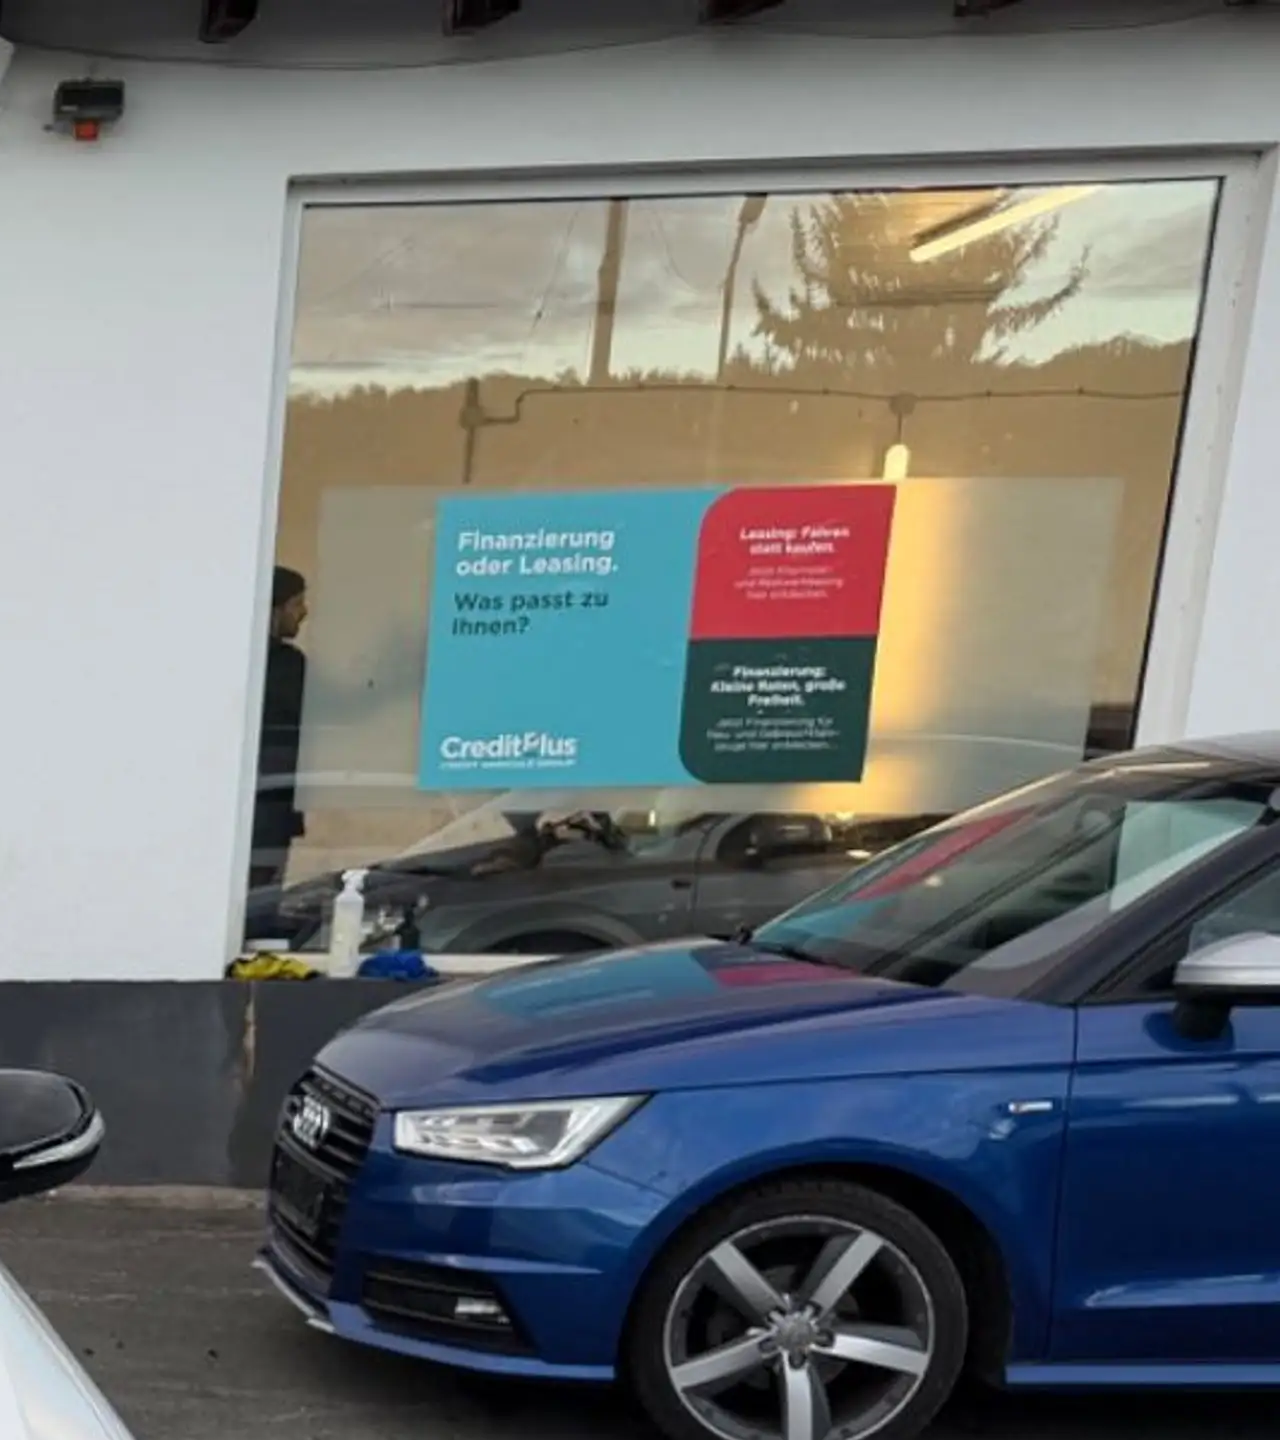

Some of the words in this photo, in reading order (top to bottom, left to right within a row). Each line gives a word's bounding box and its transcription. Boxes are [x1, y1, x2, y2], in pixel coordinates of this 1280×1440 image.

[458, 529, 616, 551] Finanzierung
[456, 556, 513, 577] oder
[519, 553, 619, 576] Leasing.
[454, 591, 504, 612] Was
[510, 590, 574, 613] passt
[580, 591, 610, 607] zu
[452, 616, 531, 637] Ihnen?
[440, 731, 578, 758] CreditPlus
